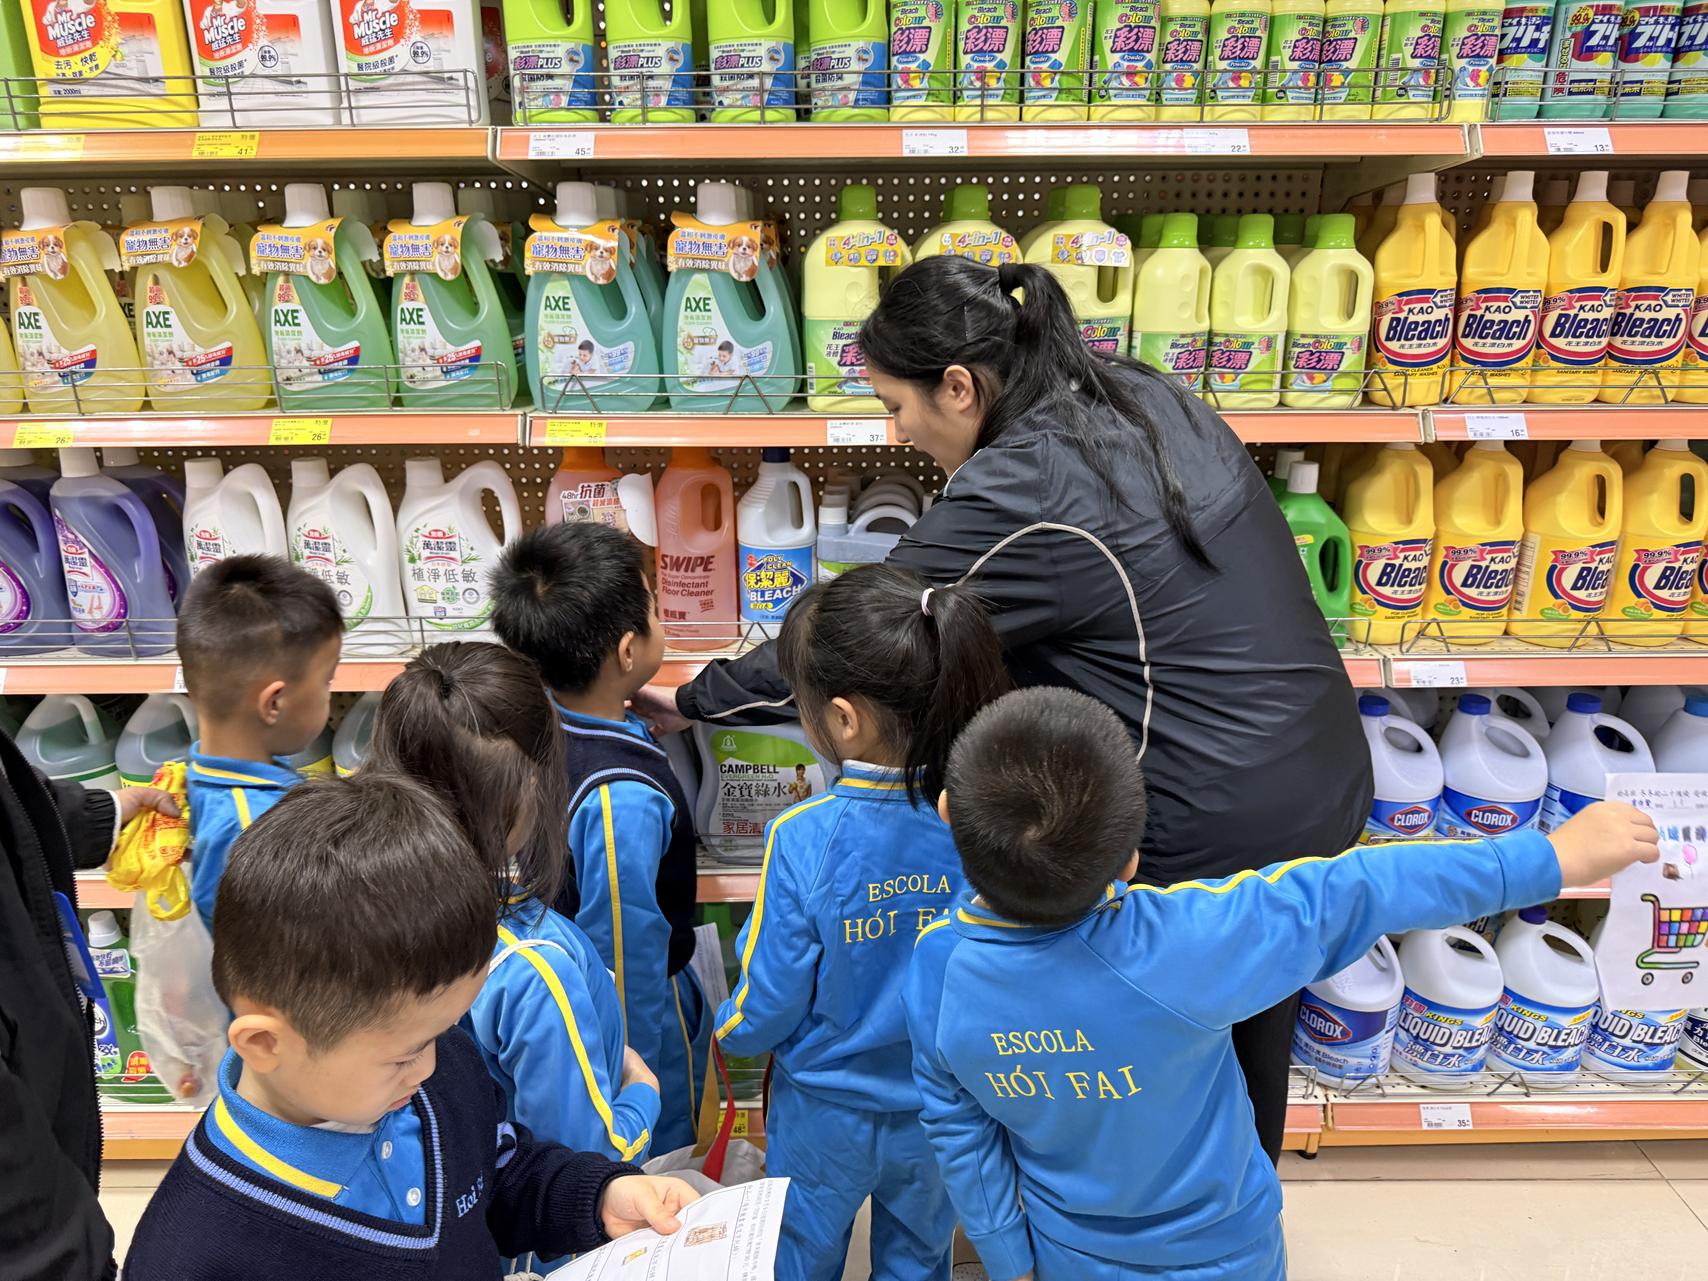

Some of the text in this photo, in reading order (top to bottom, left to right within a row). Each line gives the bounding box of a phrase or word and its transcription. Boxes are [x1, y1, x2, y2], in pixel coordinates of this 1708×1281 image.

[353, 12, 399, 41] Muscle
[967, 15, 1004, 27] Colour
[1118, 13, 1153, 25] Colour
[47, 14, 97, 41] Muscle
[203, 18, 247, 46] Muscle
[1169, 29, 1201, 39] Colour
[1226, 25, 1259, 36] Colour
[1467, 23, 1498, 33] Colour
[892, 26, 932, 56] 彩漂
[962, 26, 1009, 55] 彩漂
[1027, 26, 1064, 56] 彩漂
[1111, 25, 1157, 54] 彩漂
[1457, 33, 1499, 59] 彩漂
[1162, 39, 1204, 64] 彩漂
[1219, 35, 1263, 61] 彩漂
[575, 148, 586, 156] 45
[948, 145, 960, 154] 32
[1231, 144, 1242, 153] 22
[1594, 143, 1604, 152] 13
[125, 238, 171, 256] 寵物無害
[842, 230, 885, 250] 4-in-1
[956, 230, 1001, 249] 4-in-1
[256, 243, 305, 259] 寵物無害
[388, 243, 433, 259] 寵物無害
[531, 244, 585, 261] 寵物無害
[674, 240, 728, 257] 寵物無害
[544, 296, 571, 311] AXE
[684, 297, 711, 313] AXE
[1407, 303, 1434, 315] KAO
[1483, 304, 1513, 315] KAO
[1577, 303, 1604, 314] KAO
[1632, 303, 1662, 314] KAO
[18, 311, 42, 330] AXE
[145, 311, 173, 329] AXE
[274, 309, 302, 327] AXE
[400, 307, 425, 325] AXE
[1384, 316, 1451, 342] Bleach
[1461, 313, 1532, 341] Bleach
[1548, 315, 1613, 340] Bleac
[1611, 315, 1684, 340] Bleach
[1222, 338, 1256, 350] Colour
[1311, 338, 1348, 351] Colour
[1207, 350, 1252, 370] 彩漂
[1293, 350, 1345, 371] 彩漂
[312, 433, 323, 442] 26
[870, 433, 880, 443] 37
[1510, 429, 1520, 438] 16
[580, 484, 606, 499] 抗菌
[1365, 546, 1391, 556] 99.9%
[1402, 553, 1425, 563] KAO
[1451, 548, 1477, 557] 99.9%
[1560, 550, 1588, 561] 99.9%
[1643, 550, 1673, 560] 99.9%
[661, 554, 715, 573] SWIPE
[768, 561, 793, 570] CLEAN
[1489, 555, 1511, 565] KAO
[412, 568, 479, 584] 植淨低敏
[1375, 561, 1427, 587] Bleac
[661, 577, 709, 589] Disinfectant
[662, 586, 714, 598] Floor Cleaner
[750, 584, 801, 601] BLEACH
[1450, 677, 1460, 685] 23
[720, 764, 779, 774] CAMPBELL
[721, 782, 787, 798] 金寶綠水
[1393, 812, 1430, 826] CLOROX
[1470, 810, 1513, 826] CLOROX
[868, 875, 952, 903] ESCOLA
[843, 908, 899, 944] HÓI
[1426, 1011, 1464, 1026] KINGS
[1510, 1004, 1549, 1022] KINGS
[1300, 1006, 1344, 1039] CLOROX
[1399, 1008, 1453, 1048] LIQUID
[1496, 1007, 1536, 1041] QUID
[990, 1029, 1095, 1055] ESCOLA
[1404, 1040, 1463, 1068] 漂白水
[984, 1064, 1143, 1101] HÓI FAI
[732, 1126, 742, 1135] 48
[1457, 1119, 1467, 1128] 35
